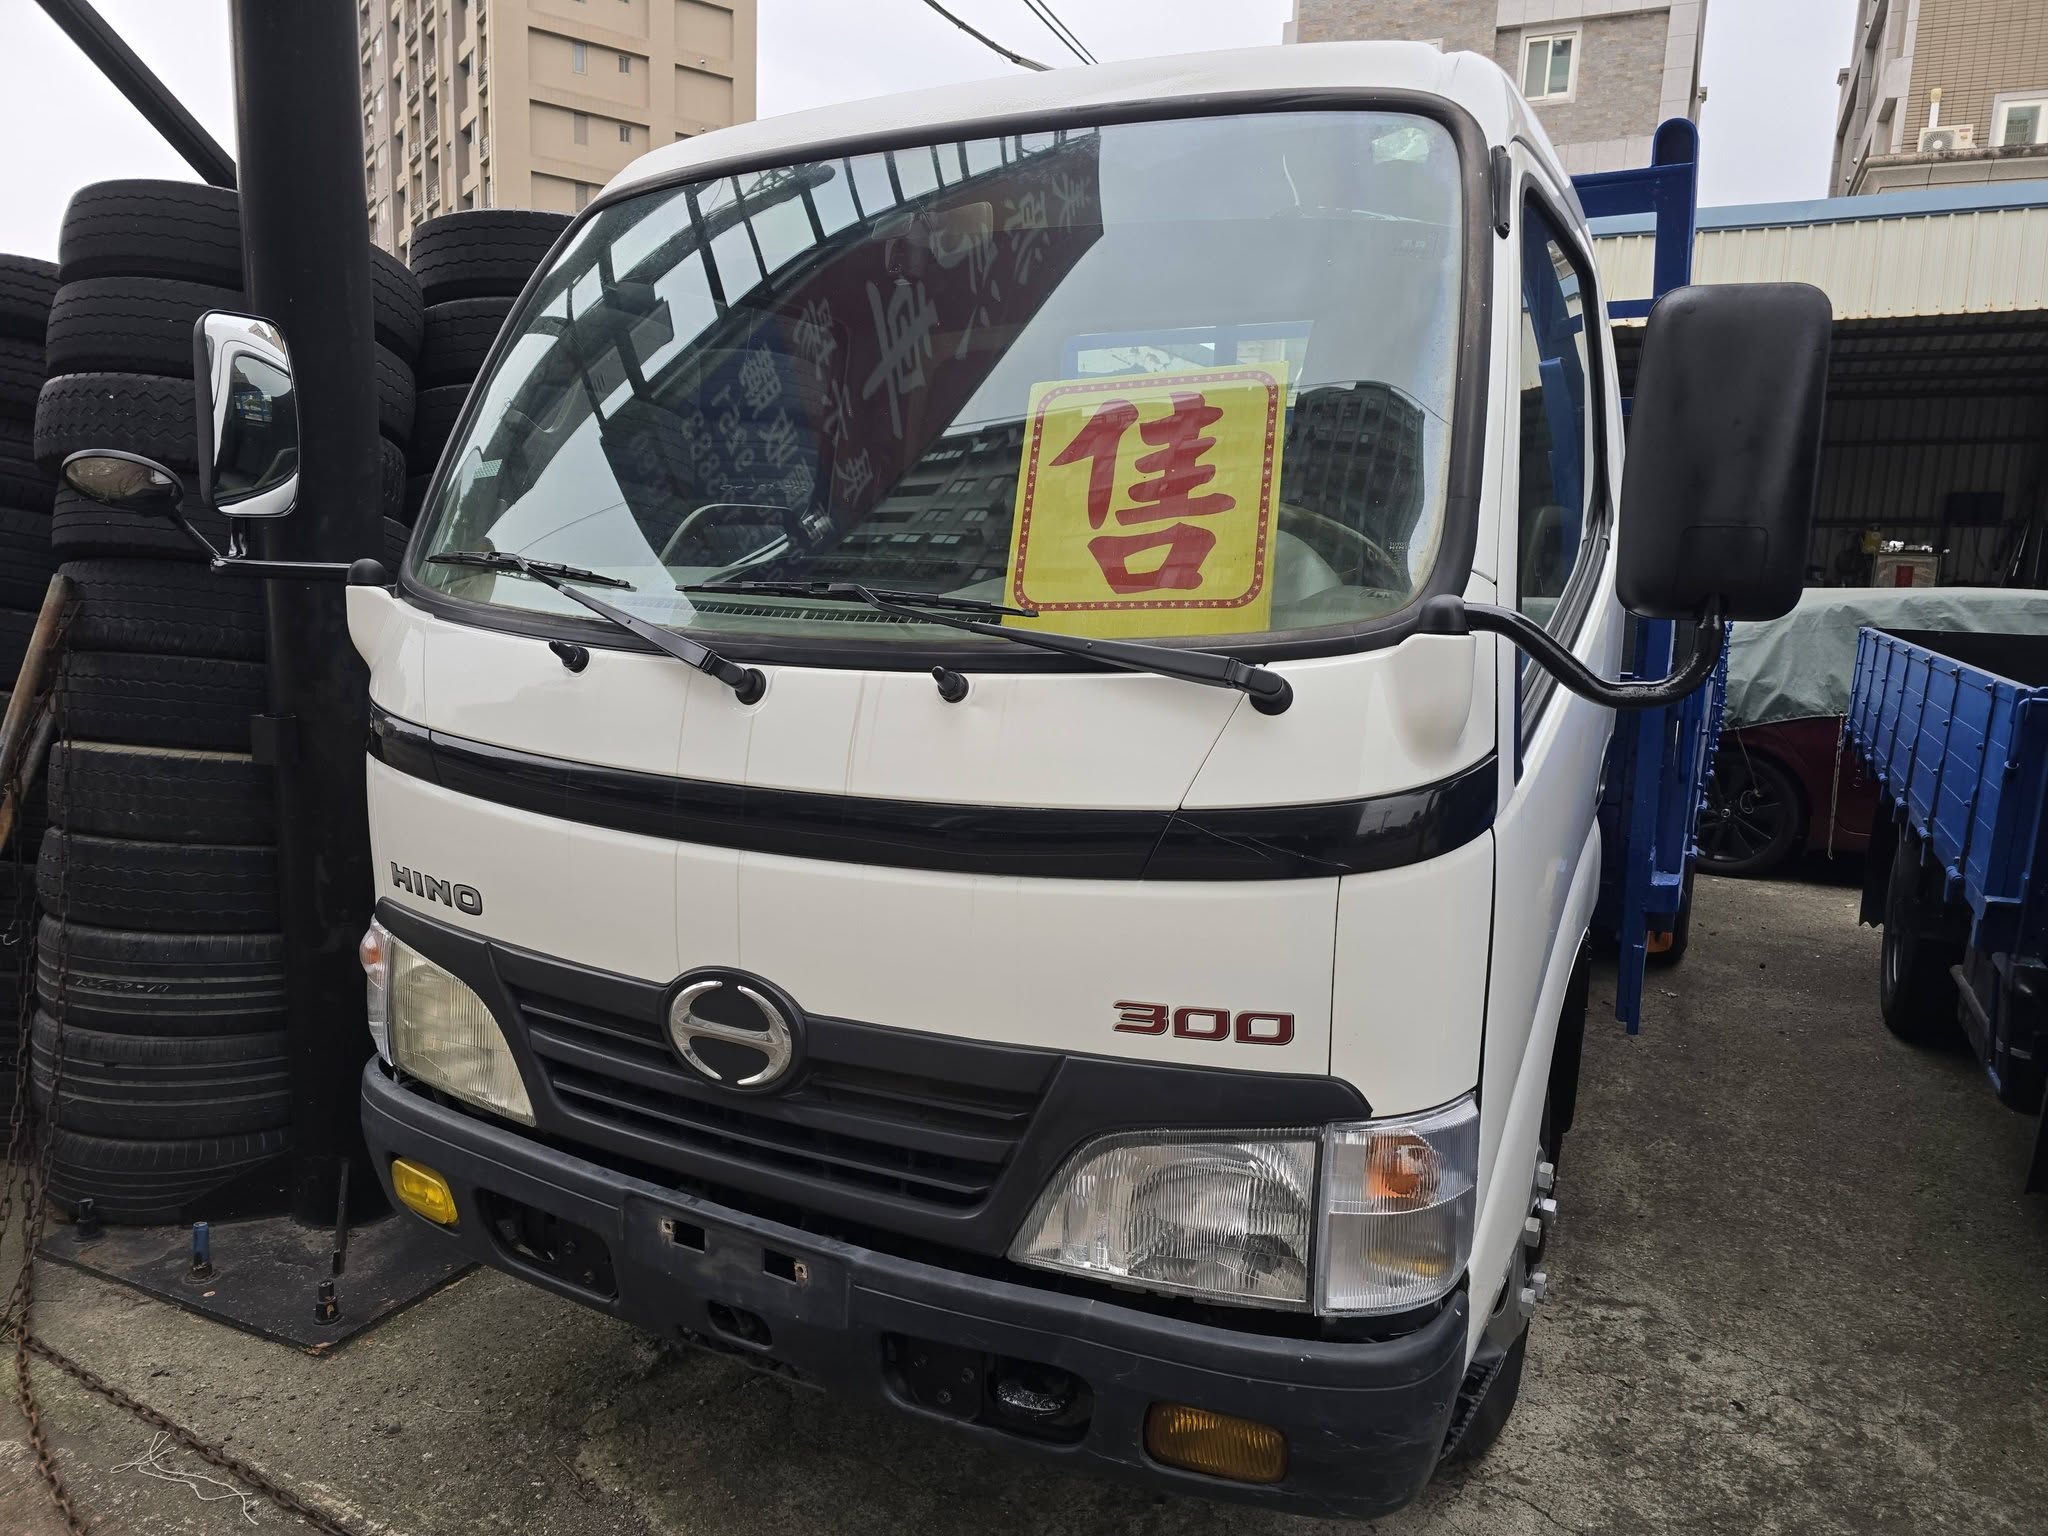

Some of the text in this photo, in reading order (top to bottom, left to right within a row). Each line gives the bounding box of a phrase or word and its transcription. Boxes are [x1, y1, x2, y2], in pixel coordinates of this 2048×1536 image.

[1048, 391, 1237, 594] 售
[390, 860, 483, 916] HINO
[1112, 999, 1296, 1047] 300
